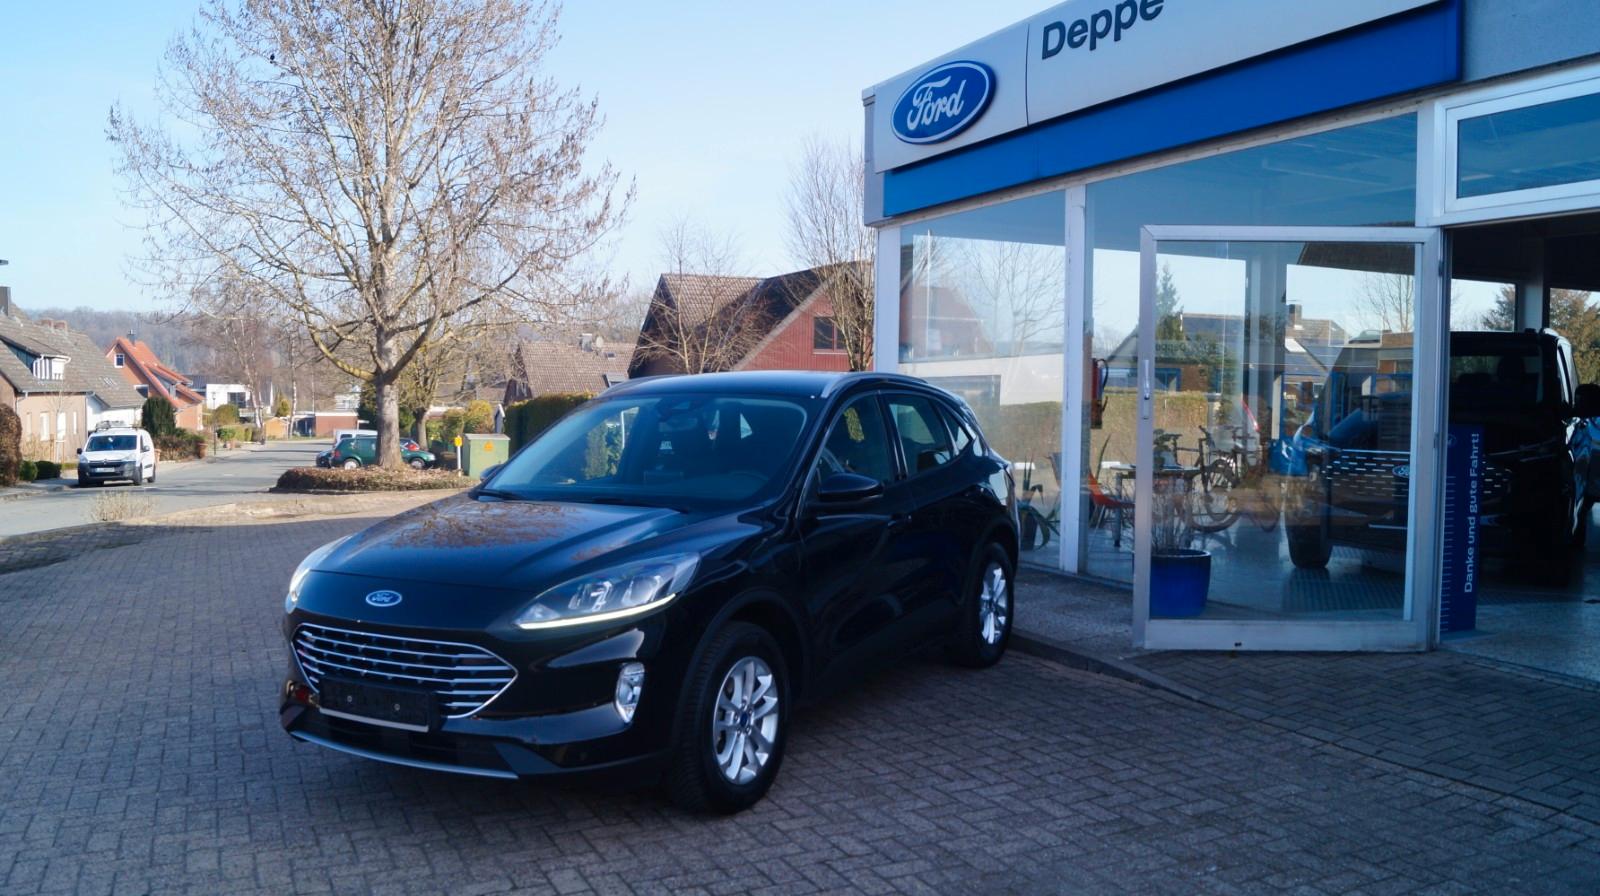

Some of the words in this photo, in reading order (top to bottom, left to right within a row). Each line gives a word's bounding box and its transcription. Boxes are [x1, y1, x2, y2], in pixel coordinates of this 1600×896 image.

[1042, 0, 1165, 60] Deppe
[907, 75, 967, 131] Ford
[1470, 433, 1479, 477] Fahrt!
[1469, 480, 1478, 513] gute
[1467, 516, 1476, 544] und
[1464, 547, 1474, 593] Danke
